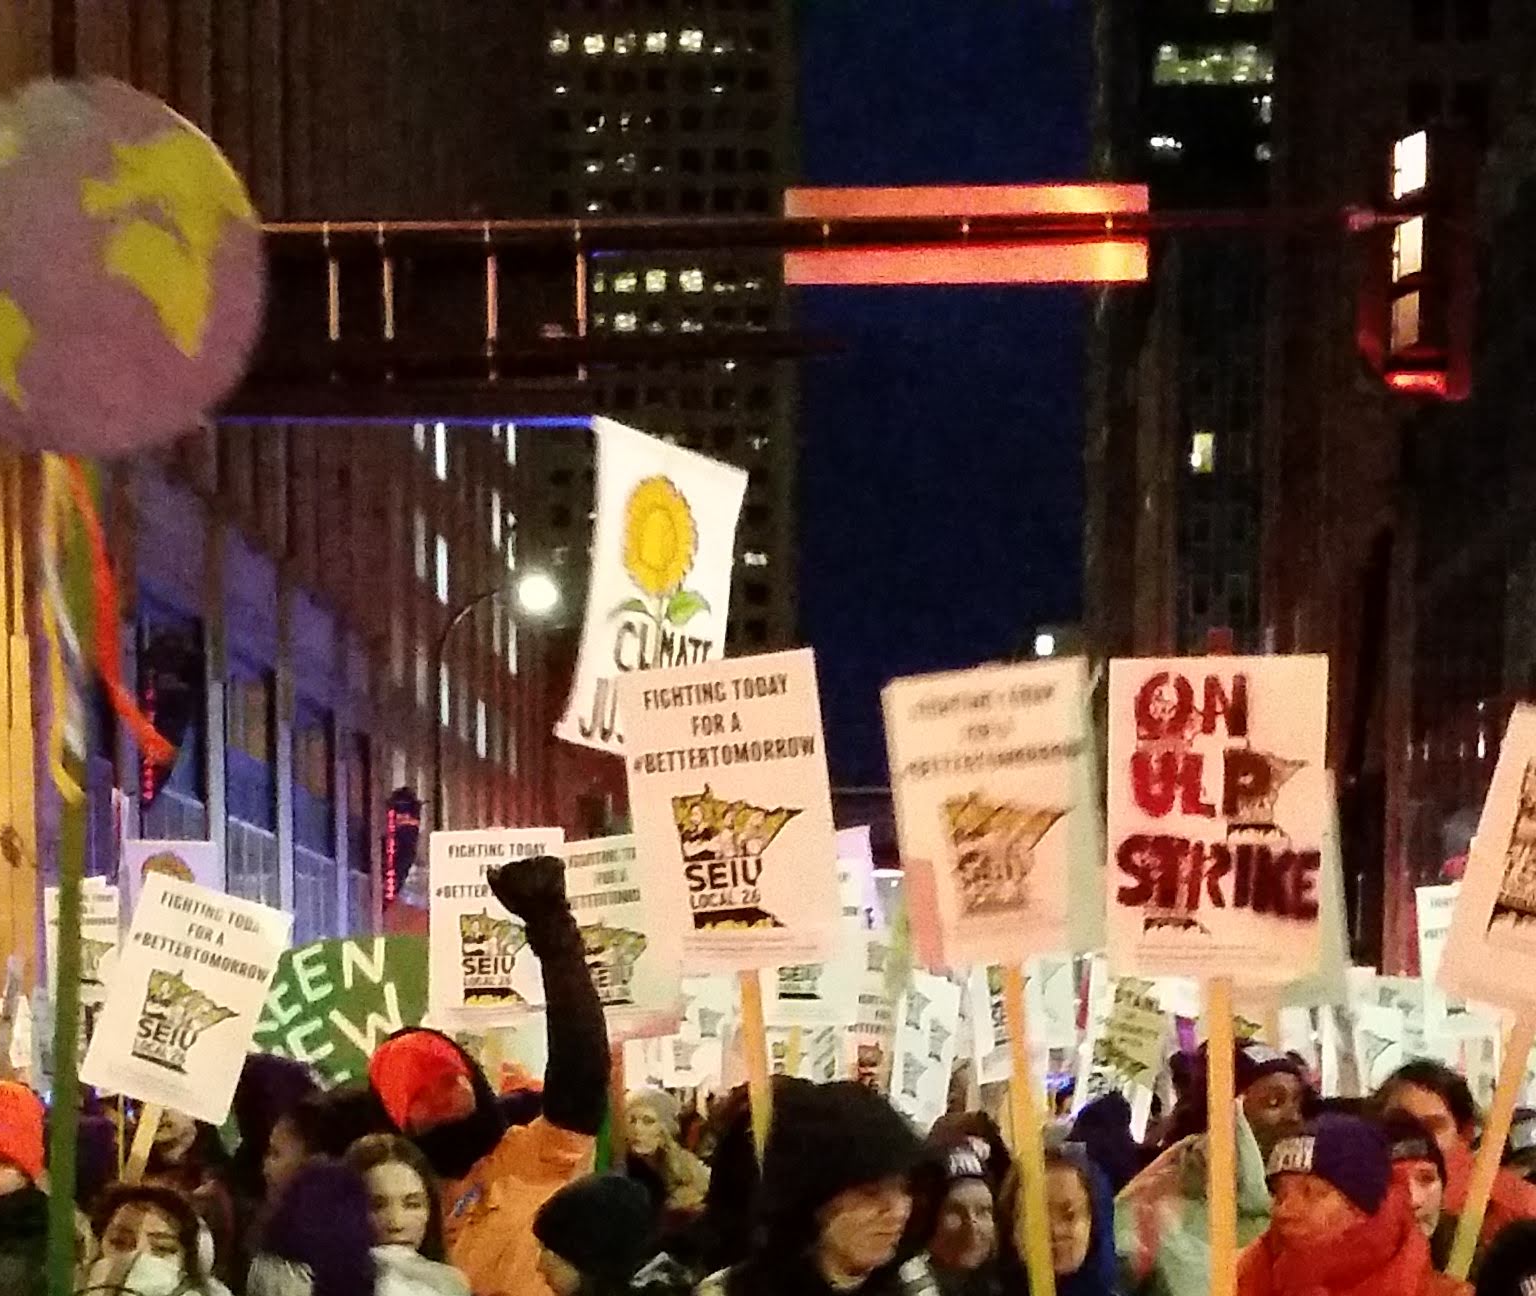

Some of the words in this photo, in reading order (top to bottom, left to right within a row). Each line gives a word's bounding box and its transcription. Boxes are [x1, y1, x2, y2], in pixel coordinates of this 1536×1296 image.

[643, 681, 727, 710] FIGHTING
[732, 673, 789, 700] TODAY
[1135, 671, 1250, 736] ON
[691, 713, 726, 738] FOR
[731, 711, 742, 733] A
[634, 735, 815, 775] #BETTERTOMORROW
[1131, 748, 1278, 818] ULP
[683, 857, 763, 892] SEIU
[1115, 833, 1322, 921] STRIKE
[160, 890, 224, 922] FIGHTING
[689, 889, 734, 910] LOCAL
[187, 922, 214, 941] FOR
[215, 931, 226, 948] A
[461, 955, 516, 976] SEIU
[137, 1017, 200, 1050] SEIU
